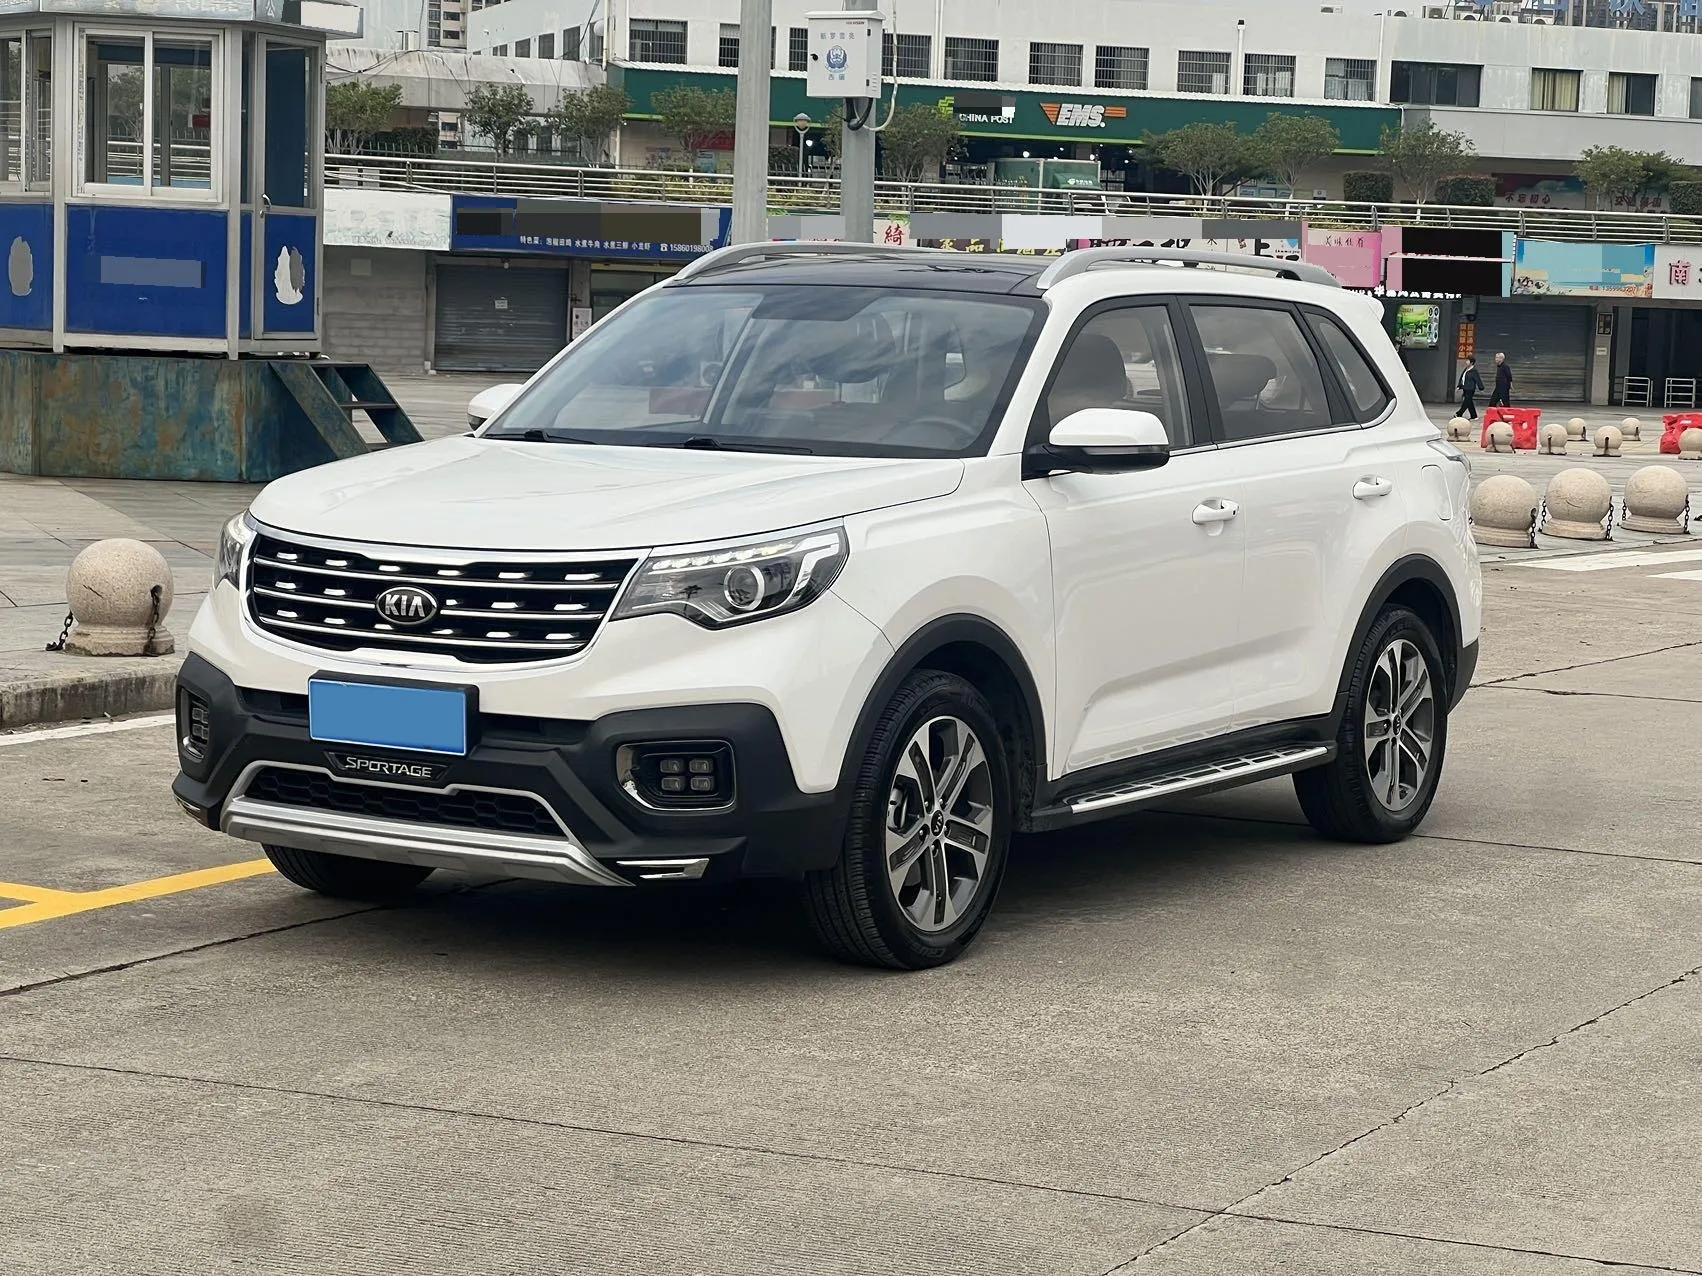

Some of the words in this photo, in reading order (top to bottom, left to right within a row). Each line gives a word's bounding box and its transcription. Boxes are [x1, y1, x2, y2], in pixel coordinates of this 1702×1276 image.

[959, 113, 989, 123] CHINA
[991, 115, 1015, 124] POST
[385, 594, 425, 617] KIA
[344, 757, 432, 777] SPORTAGE
